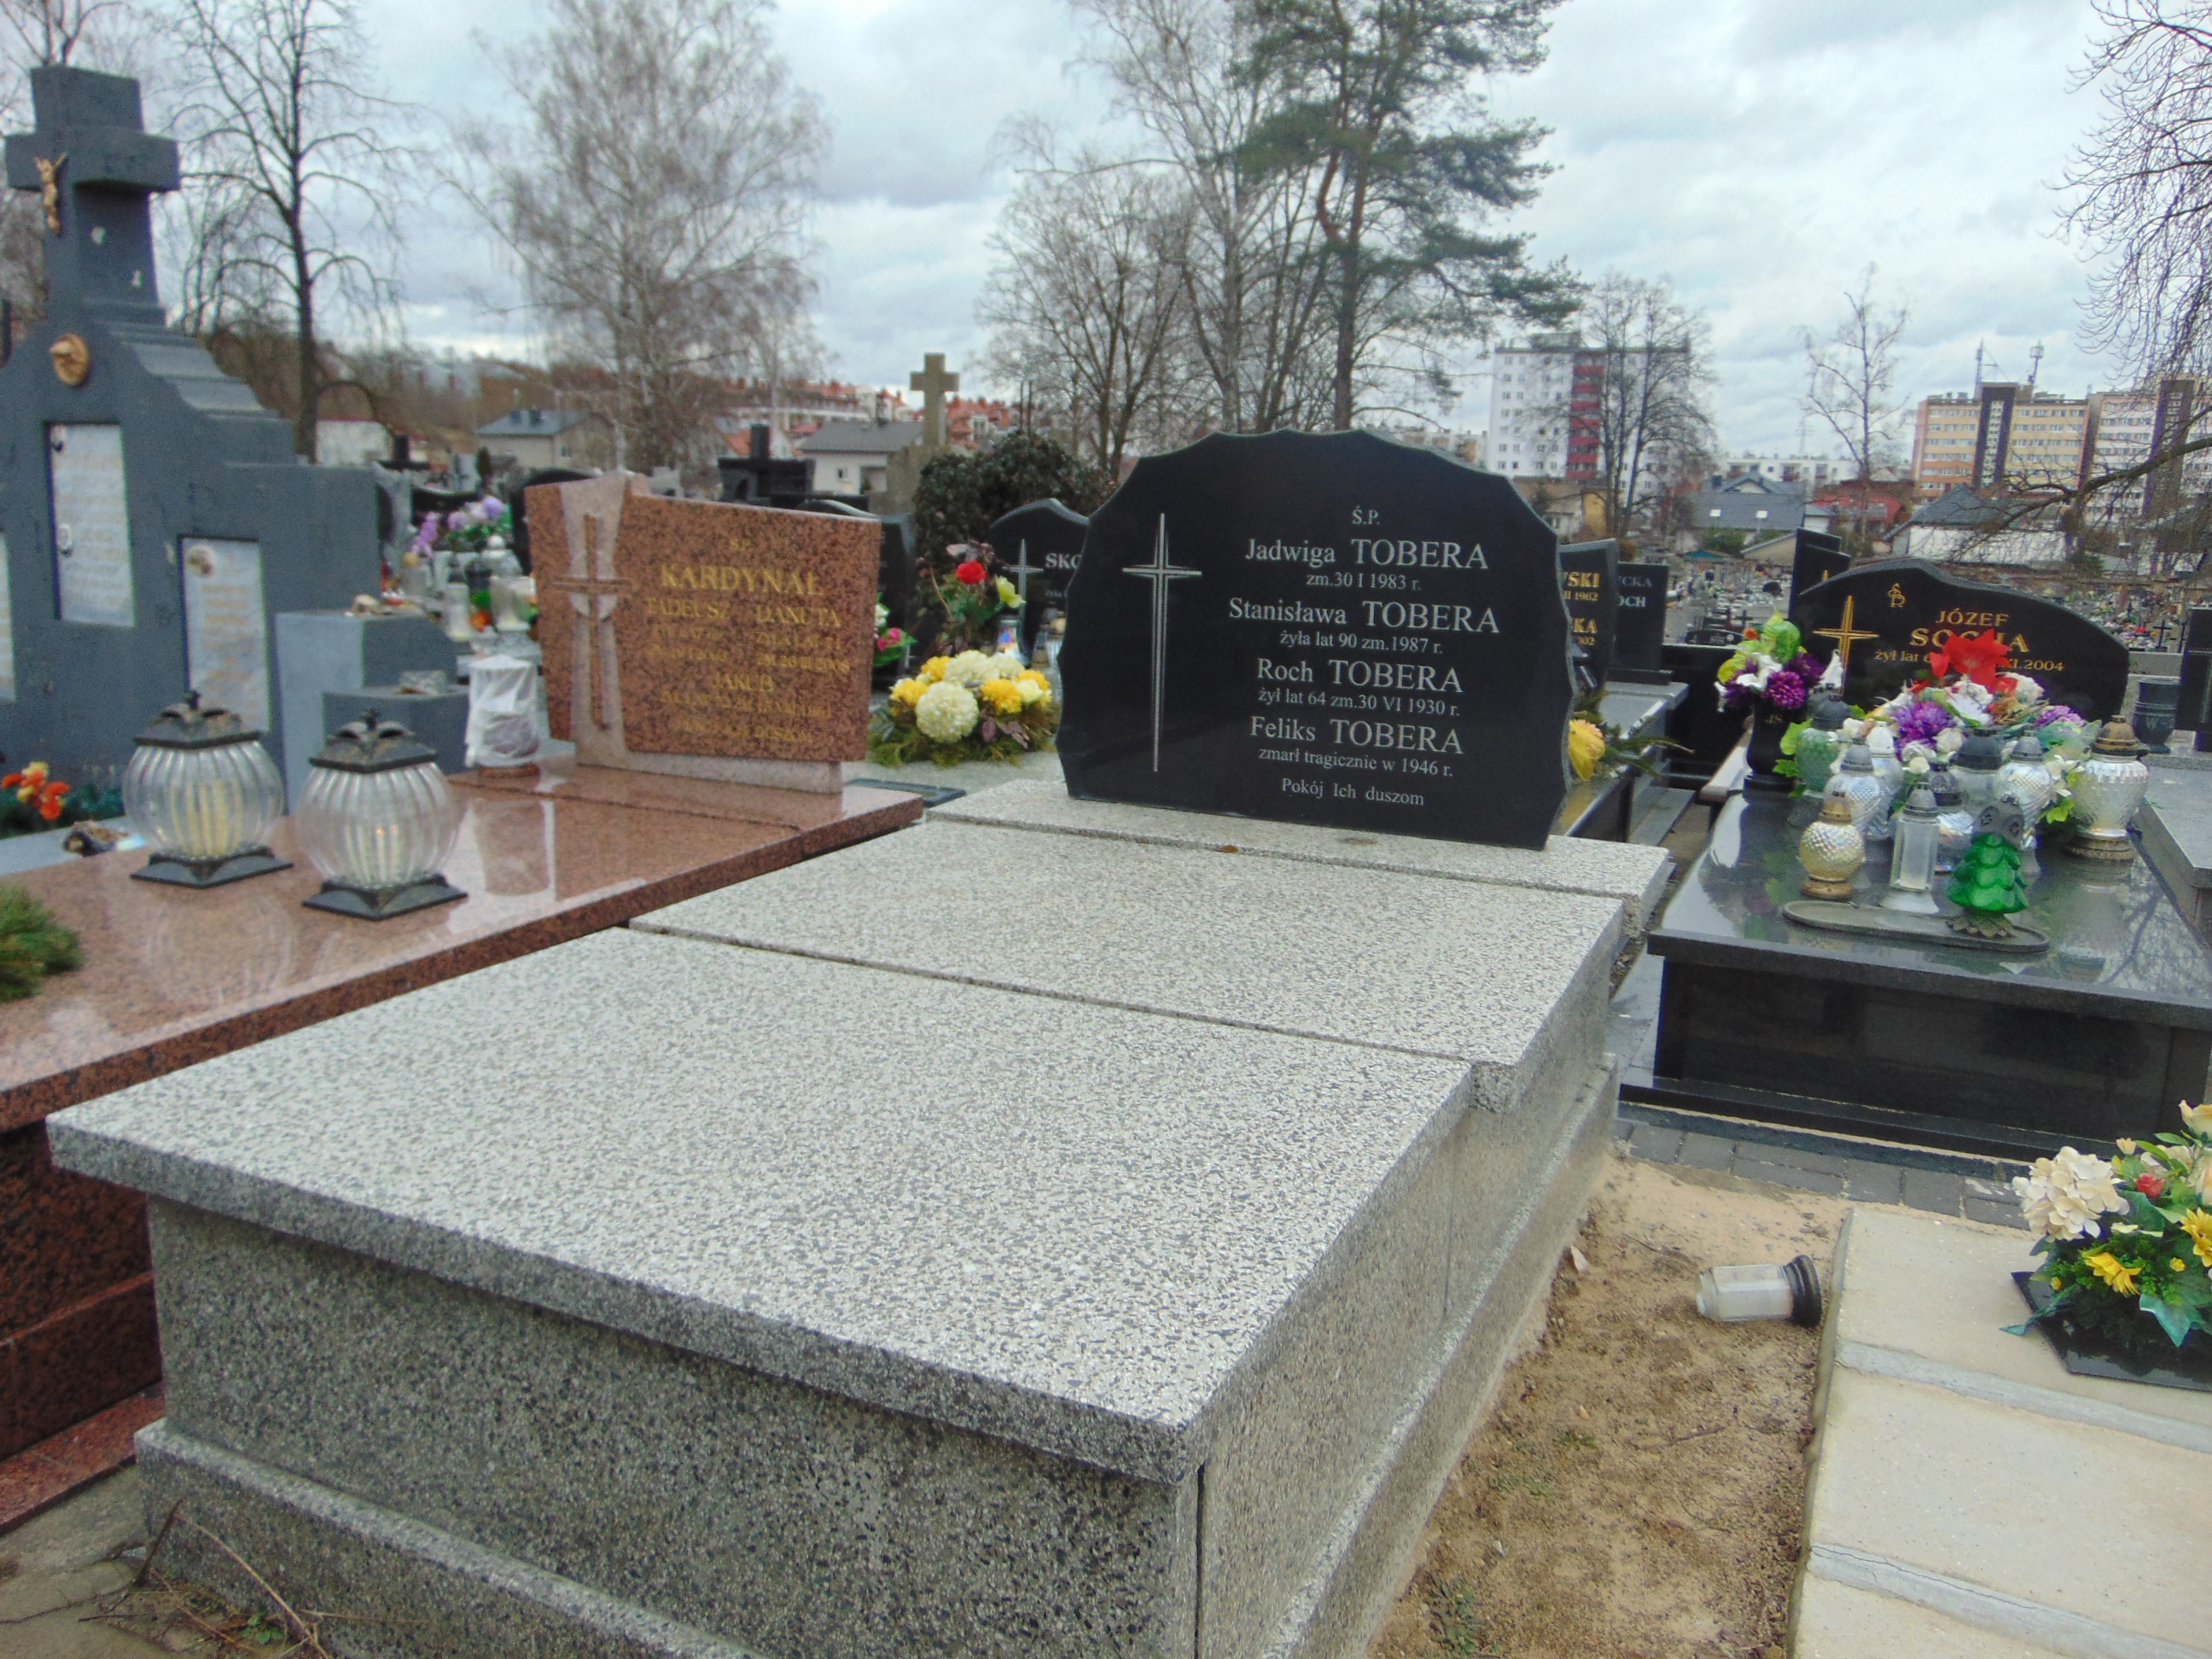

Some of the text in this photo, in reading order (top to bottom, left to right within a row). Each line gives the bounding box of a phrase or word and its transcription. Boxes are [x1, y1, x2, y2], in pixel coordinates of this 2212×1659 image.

[1245, 538, 1489, 570] Jadwiga TOBERA
[661, 563, 826, 596] KARDYNAŁ
[1307, 572, 1353, 587] zm.30
[1370, 573, 1407, 590] 1983
[1412, 579, 1421, 591] r.
[1229, 597, 1500, 633] Stanisława TOBERA
[1936, 608, 2010, 626] JÓZEF
[1280, 631, 1444, 655] żyła lat 90 zm.1987 r.
[1257, 658, 1464, 693] Roch TOBERA
[1258, 687, 1282, 705] żył
[1285, 688, 1303, 704] lat
[1308, 691, 1326, 706] 64
[1382, 697, 1401, 712] VI
[1408, 698, 1446, 715] 1930
[1449, 705, 1460, 717] r.
[1250, 716, 1464, 754] Feliks TOBERA
[1258, 747, 1454, 777] zmarł tragicznie w 1946 r.
[1282, 777, 1425, 806] Pokój Ich duszom
